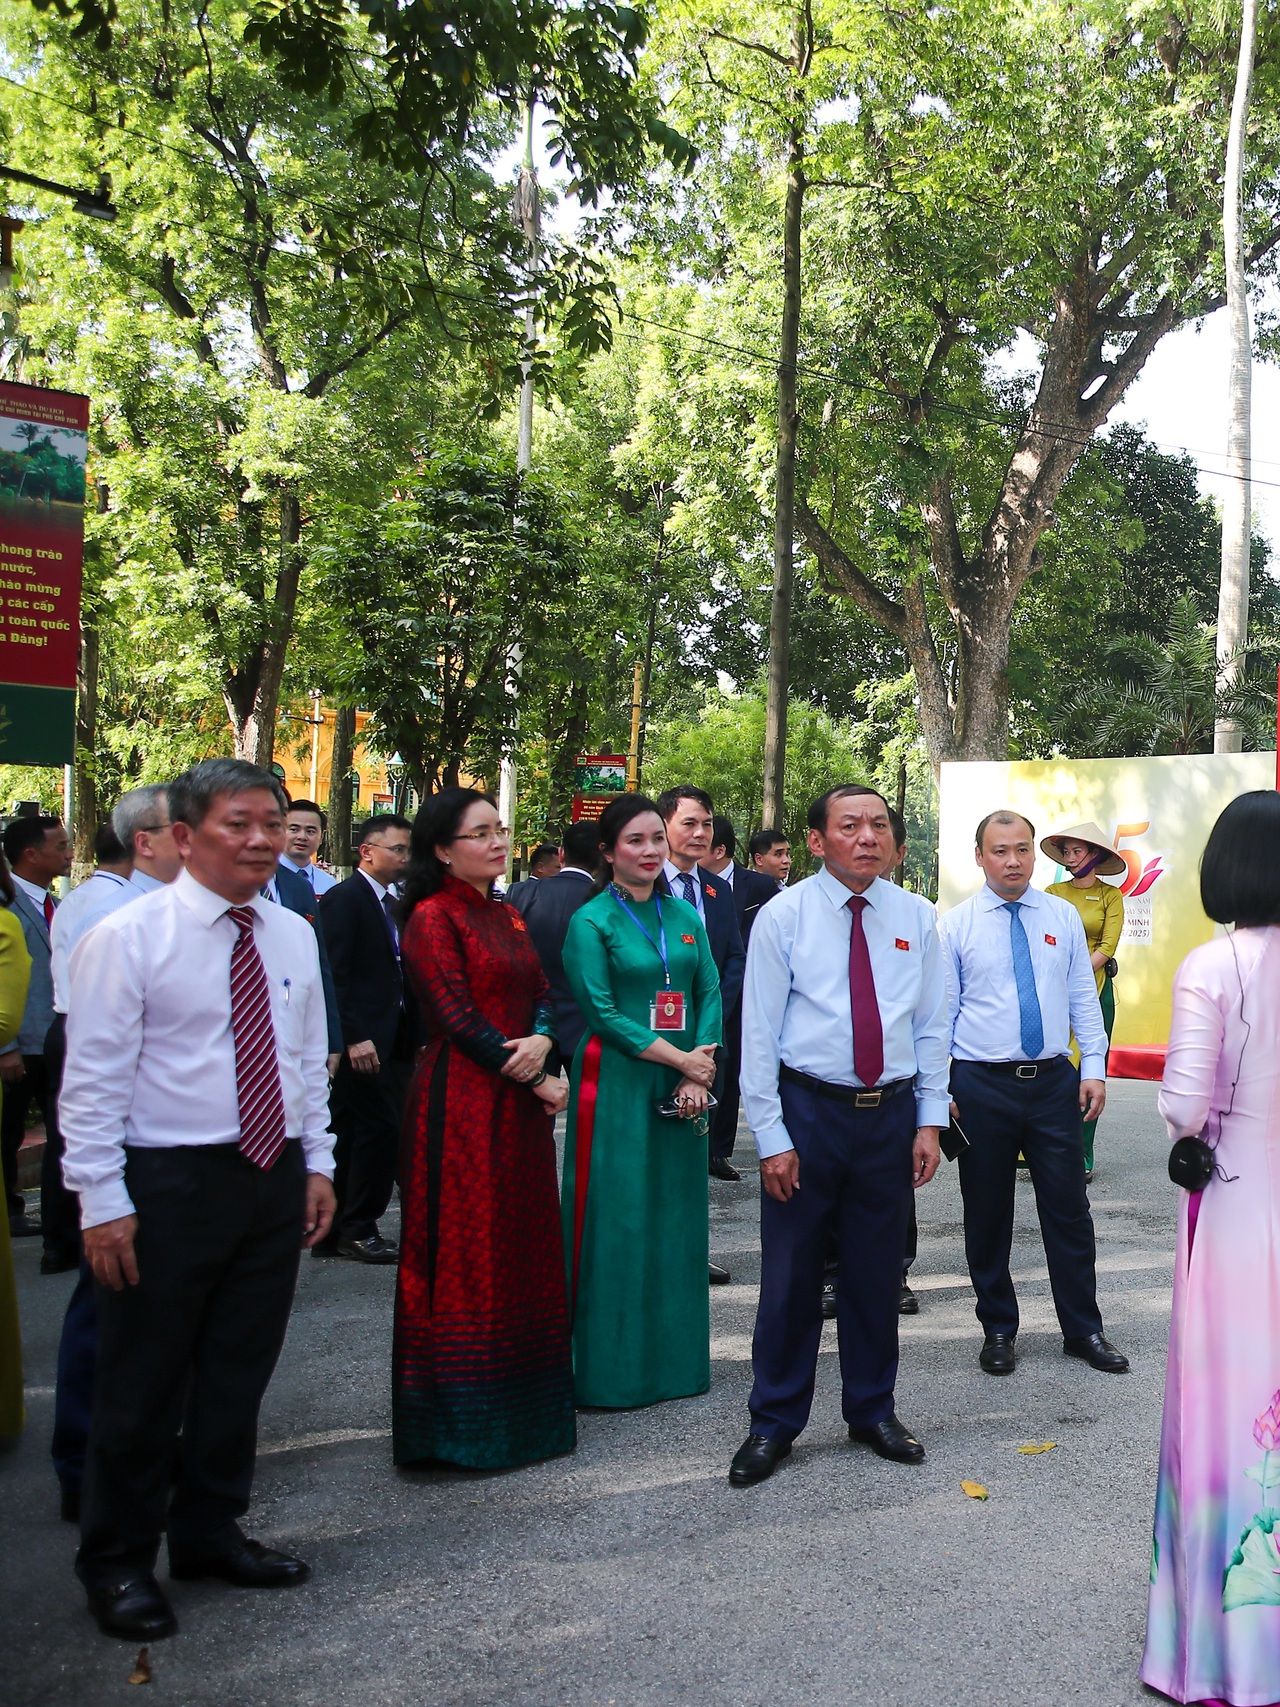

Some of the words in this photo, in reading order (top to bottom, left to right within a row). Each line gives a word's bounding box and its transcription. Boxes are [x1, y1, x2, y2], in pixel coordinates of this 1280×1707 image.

[0, 543, 32, 558] hong
[36, 549, 62, 560] trào
[1, 563, 36, 576] nước,
[25, 583, 61, 596] mừng
[8, 598, 29, 608] các
[33, 600, 55, 612] cấp
[8, 616, 37, 627] toàn
[41, 619, 70, 630] quốc
